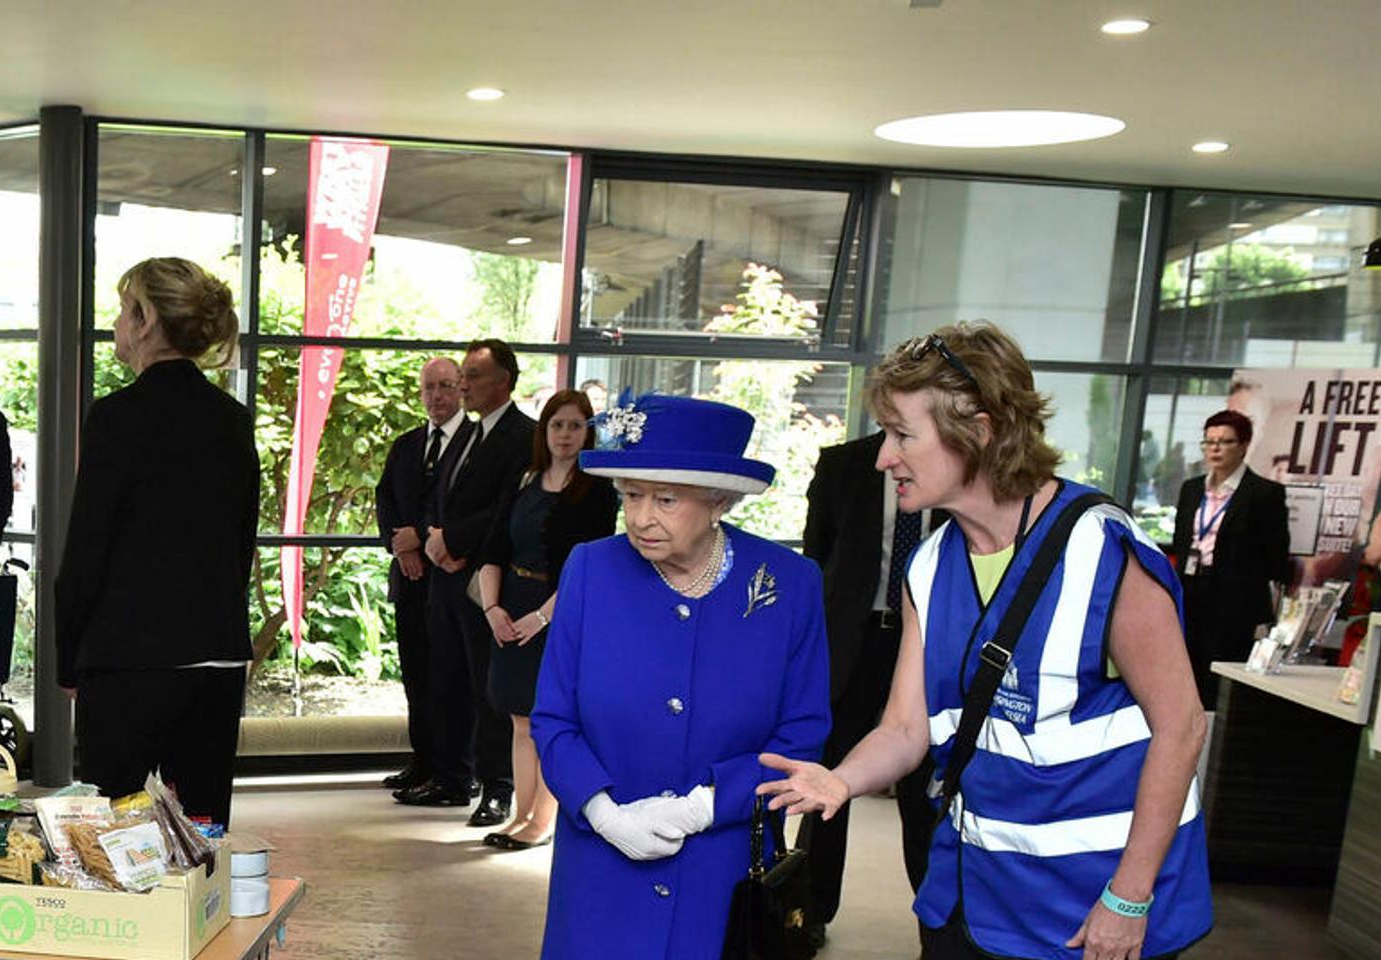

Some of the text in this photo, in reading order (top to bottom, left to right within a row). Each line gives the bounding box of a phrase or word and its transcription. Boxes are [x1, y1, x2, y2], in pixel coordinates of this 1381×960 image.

[1299, 381, 1381, 415] A FREE
[1287, 421, 1377, 476] LIFT
[36, 898, 67, 910] TESCO
